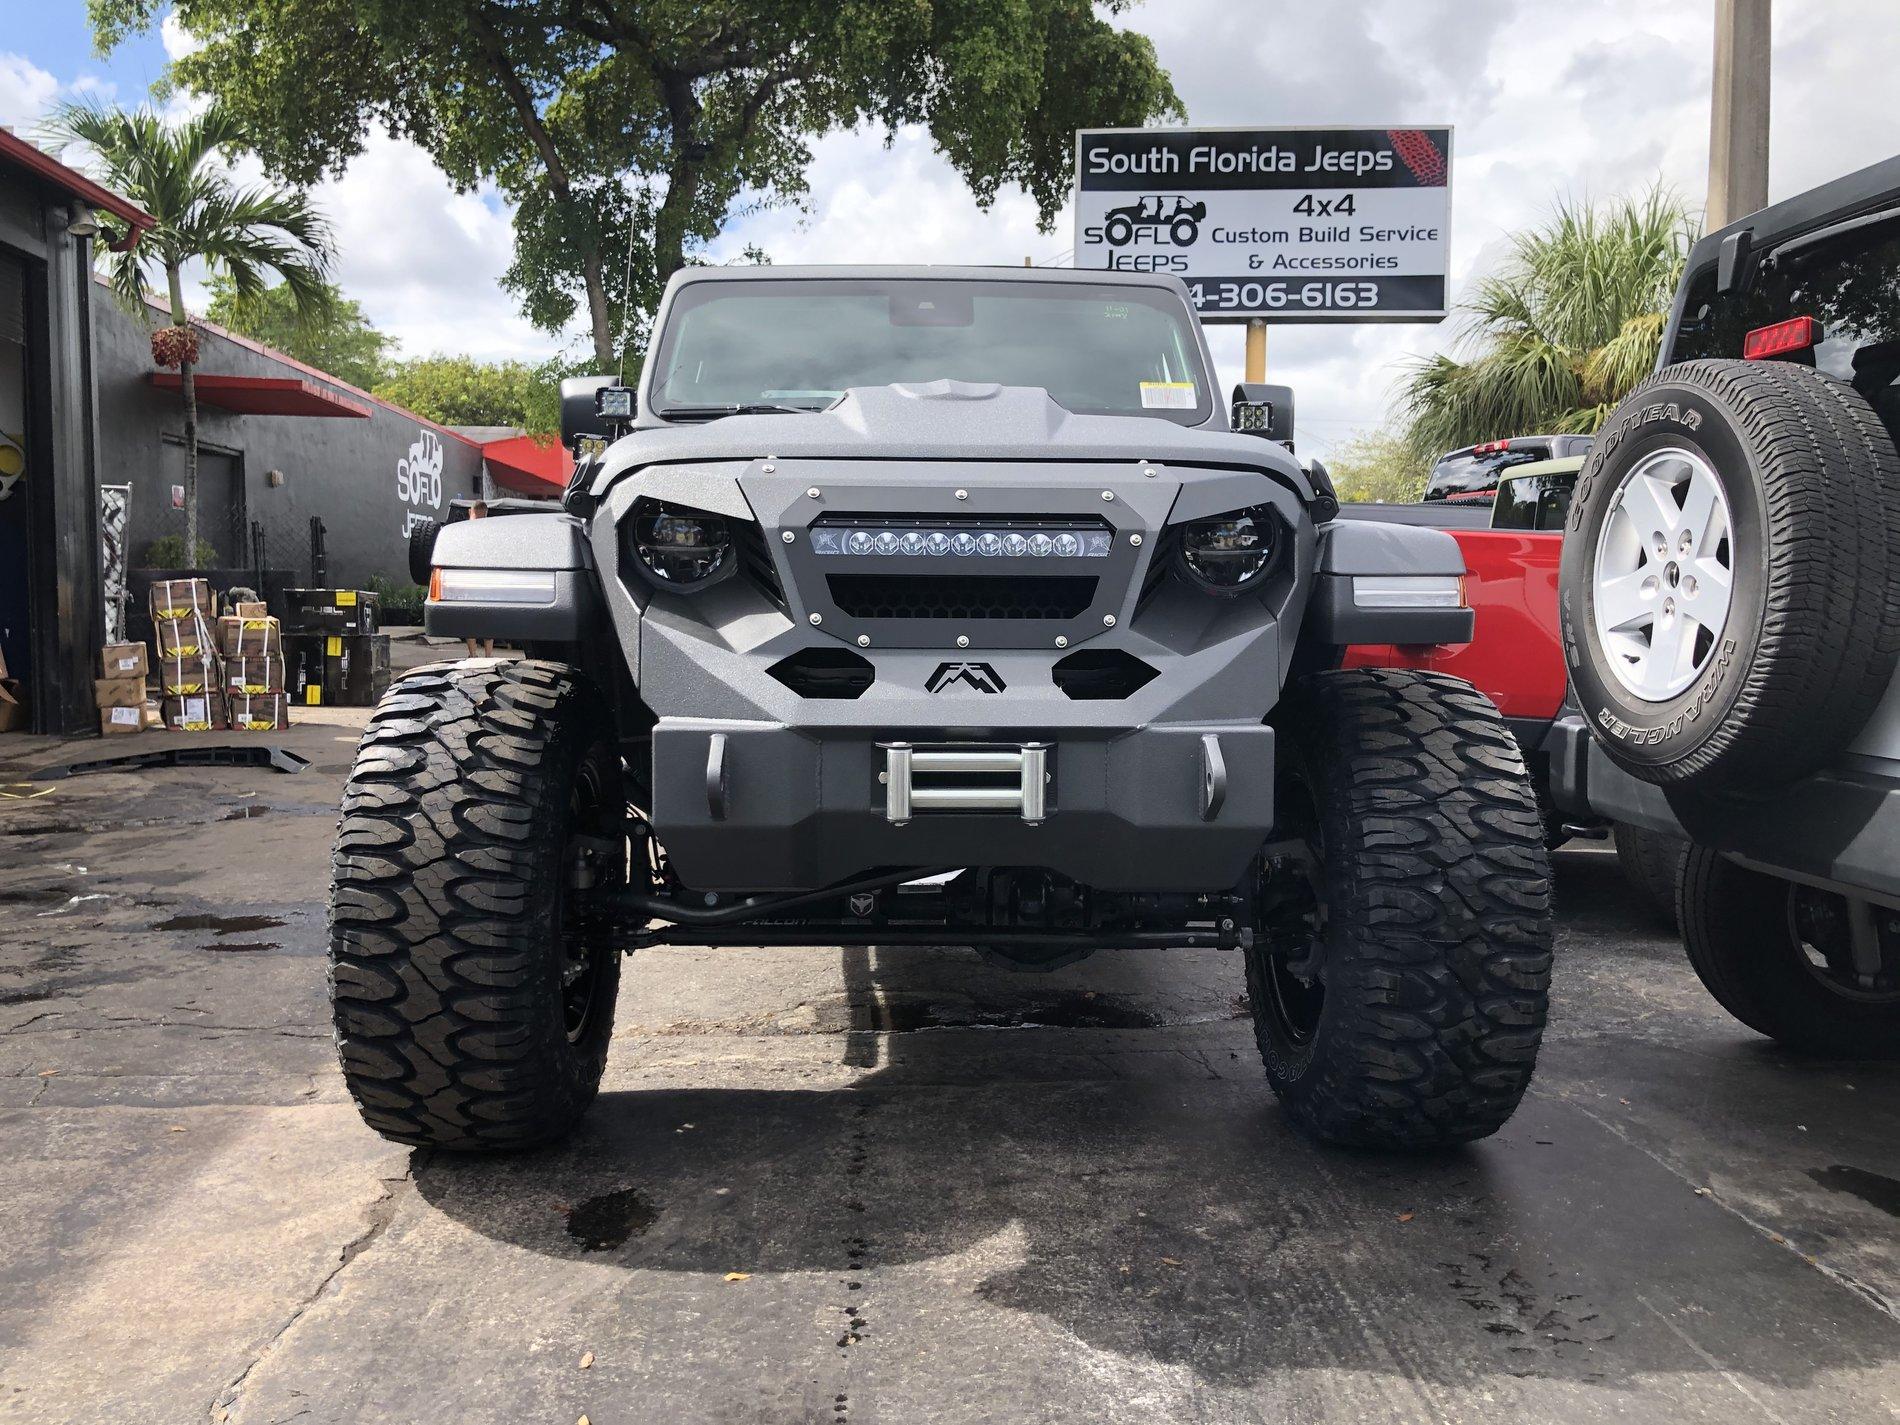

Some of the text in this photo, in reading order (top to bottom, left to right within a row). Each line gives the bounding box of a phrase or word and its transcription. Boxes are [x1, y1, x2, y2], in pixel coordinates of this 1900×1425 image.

[1089, 145, 1394, 177] South Florida Jeeps
[1293, 194, 1356, 217] 4x4
[1084, 217, 1199, 248] SOFLO
[1212, 225, 1438, 244] Custom Build Service
[1248, 253, 1399, 270] & Accessories
[1571, 402, 1704, 532] GOODYEAR
[397, 458, 442, 510] SOFLO
[1597, 639, 1737, 746] WRANGLER
